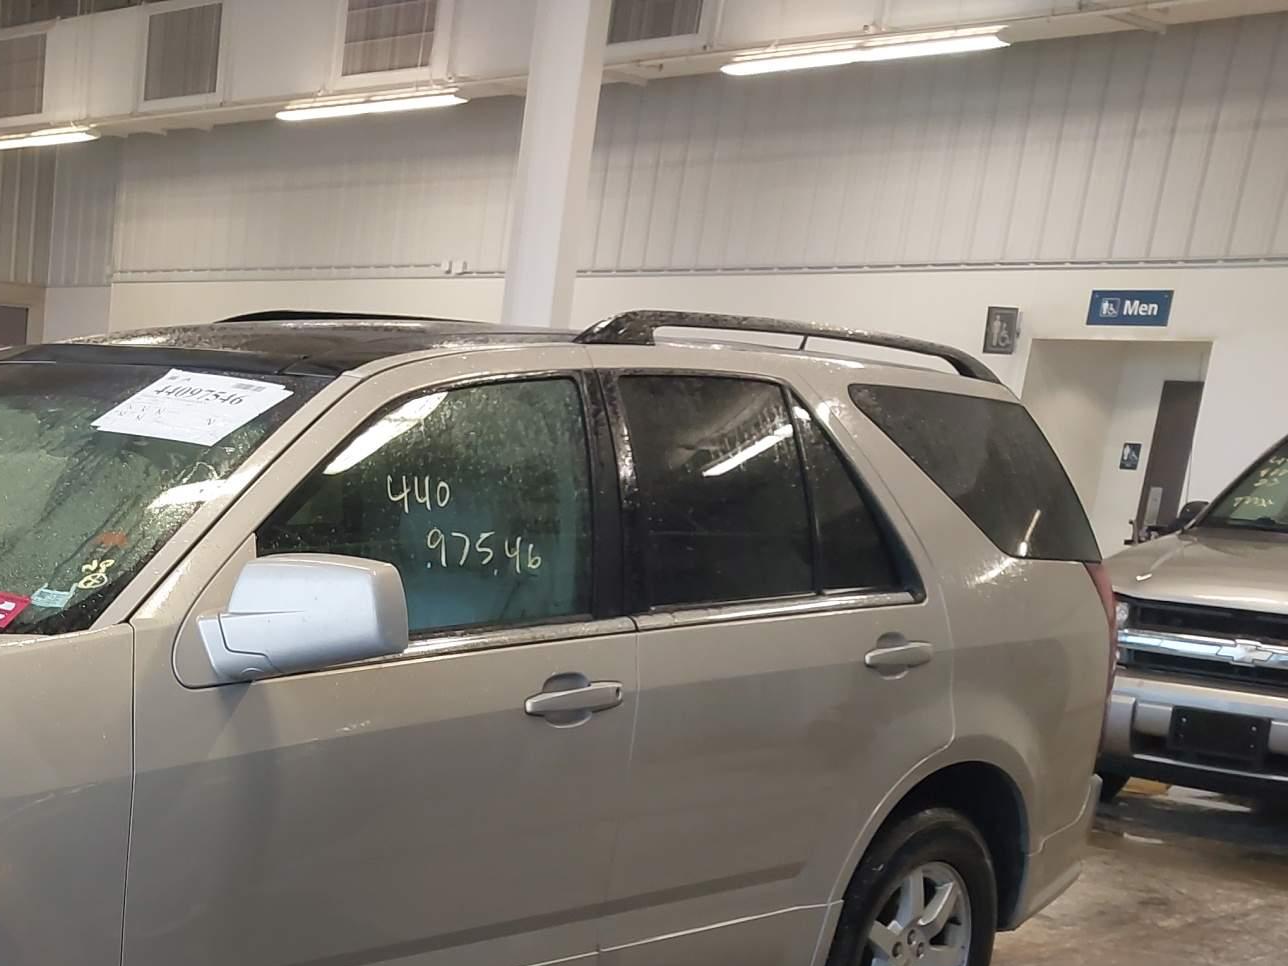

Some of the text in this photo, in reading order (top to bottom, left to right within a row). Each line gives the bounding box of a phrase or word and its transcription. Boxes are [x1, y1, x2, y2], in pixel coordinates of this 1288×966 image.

[1123, 299, 1158, 316] Men
[154, 384, 244, 406] 44097546
[387, 475, 450, 513] 440
